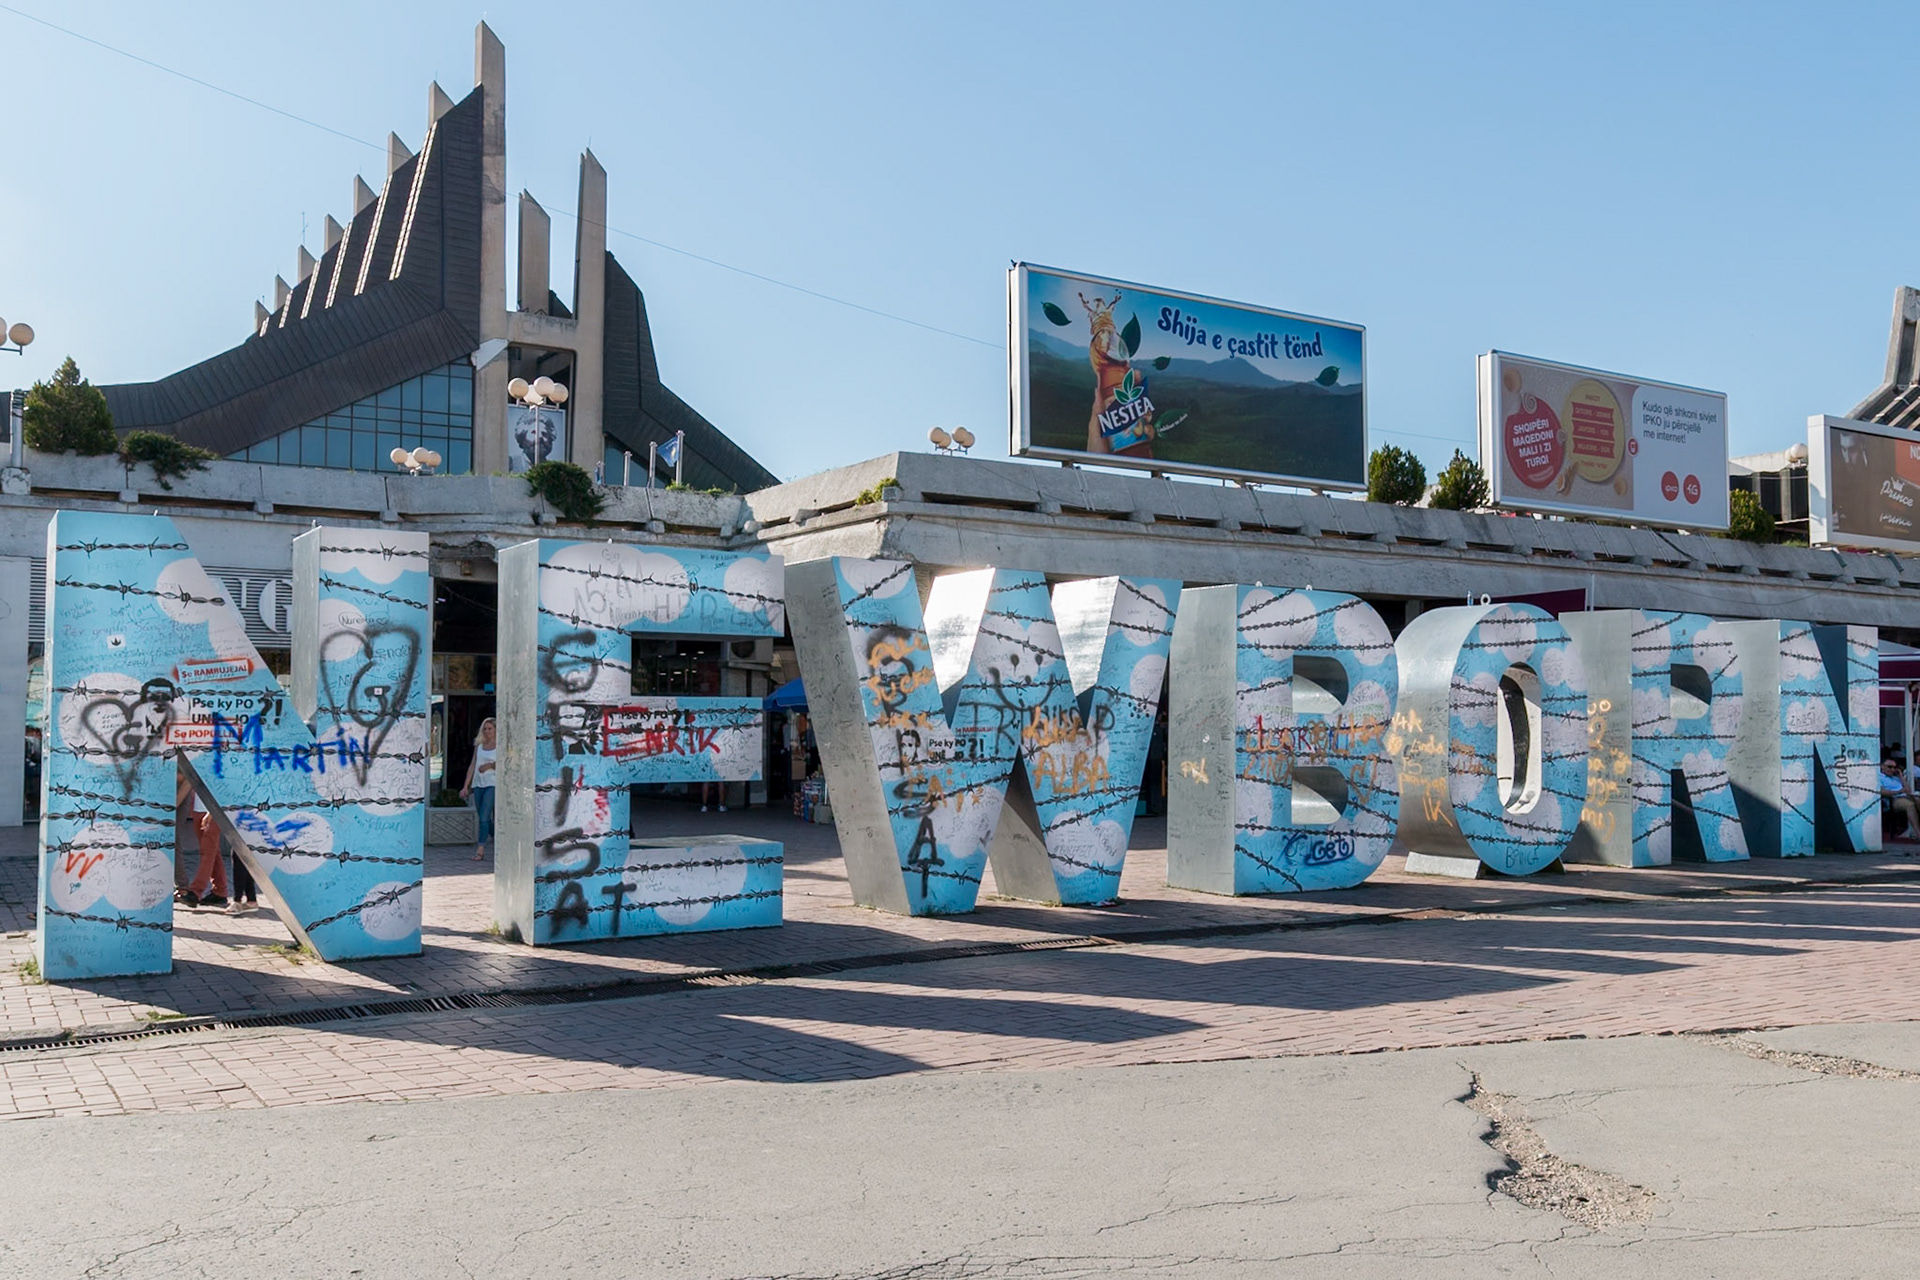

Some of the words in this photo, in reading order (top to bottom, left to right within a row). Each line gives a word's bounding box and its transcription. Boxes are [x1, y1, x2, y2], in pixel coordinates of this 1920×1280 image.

[1157, 307, 1207, 346] Shija
[1212, 334, 1222, 350] e
[1227, 332, 1279, 359] çastit
[1283, 331, 1323, 359] tënd
[1097, 396, 1155, 433] NESTEA
[1642, 400, 1661, 414] Kudo
[1674, 406, 1697, 420] shkoni
[1699, 410, 1717, 425] sivjet
[1513, 418, 1549, 435] SHQIPËRI
[1642, 413, 1662, 427] IPKO
[1663, 417, 1670, 429] ju
[1512, 430, 1554, 447] MAQEDONI
[1642, 429, 1655, 439] me
[1519, 444, 1539, 458] MALI
[1544, 442, 1552, 452] ZI
[1525, 455, 1549, 468] TURQI
[1687, 484, 1698, 495] 4G
[192, 698, 215, 709] Pse
[218, 697, 234, 712] ky
[236, 699, 254, 709] PO
[235, 713, 249, 725] JO
[929, 738, 943, 748] Pse
[944, 737, 954, 750] ky
[954, 738, 966, 748] PO
